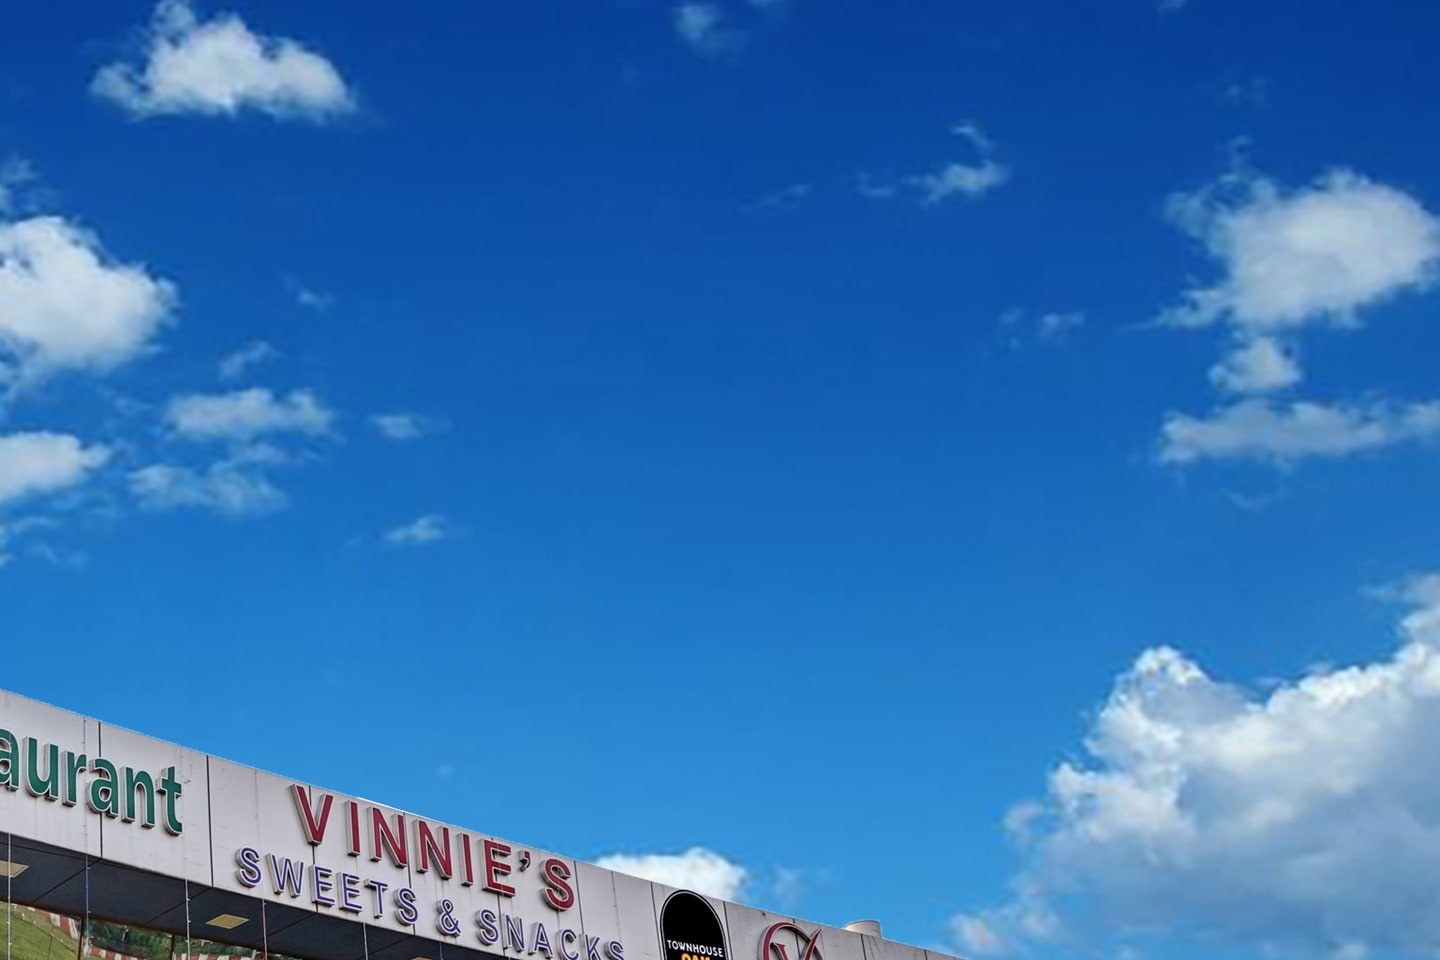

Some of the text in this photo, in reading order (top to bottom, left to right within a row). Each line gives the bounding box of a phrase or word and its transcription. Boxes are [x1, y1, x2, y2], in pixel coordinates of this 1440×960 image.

[234, 847, 419, 926] SWEETS
[435, 898, 461, 937] &
[289, 783, 575, 911] VINNIE'S
[666, 939, 724, 958] TOWNHOUSE
